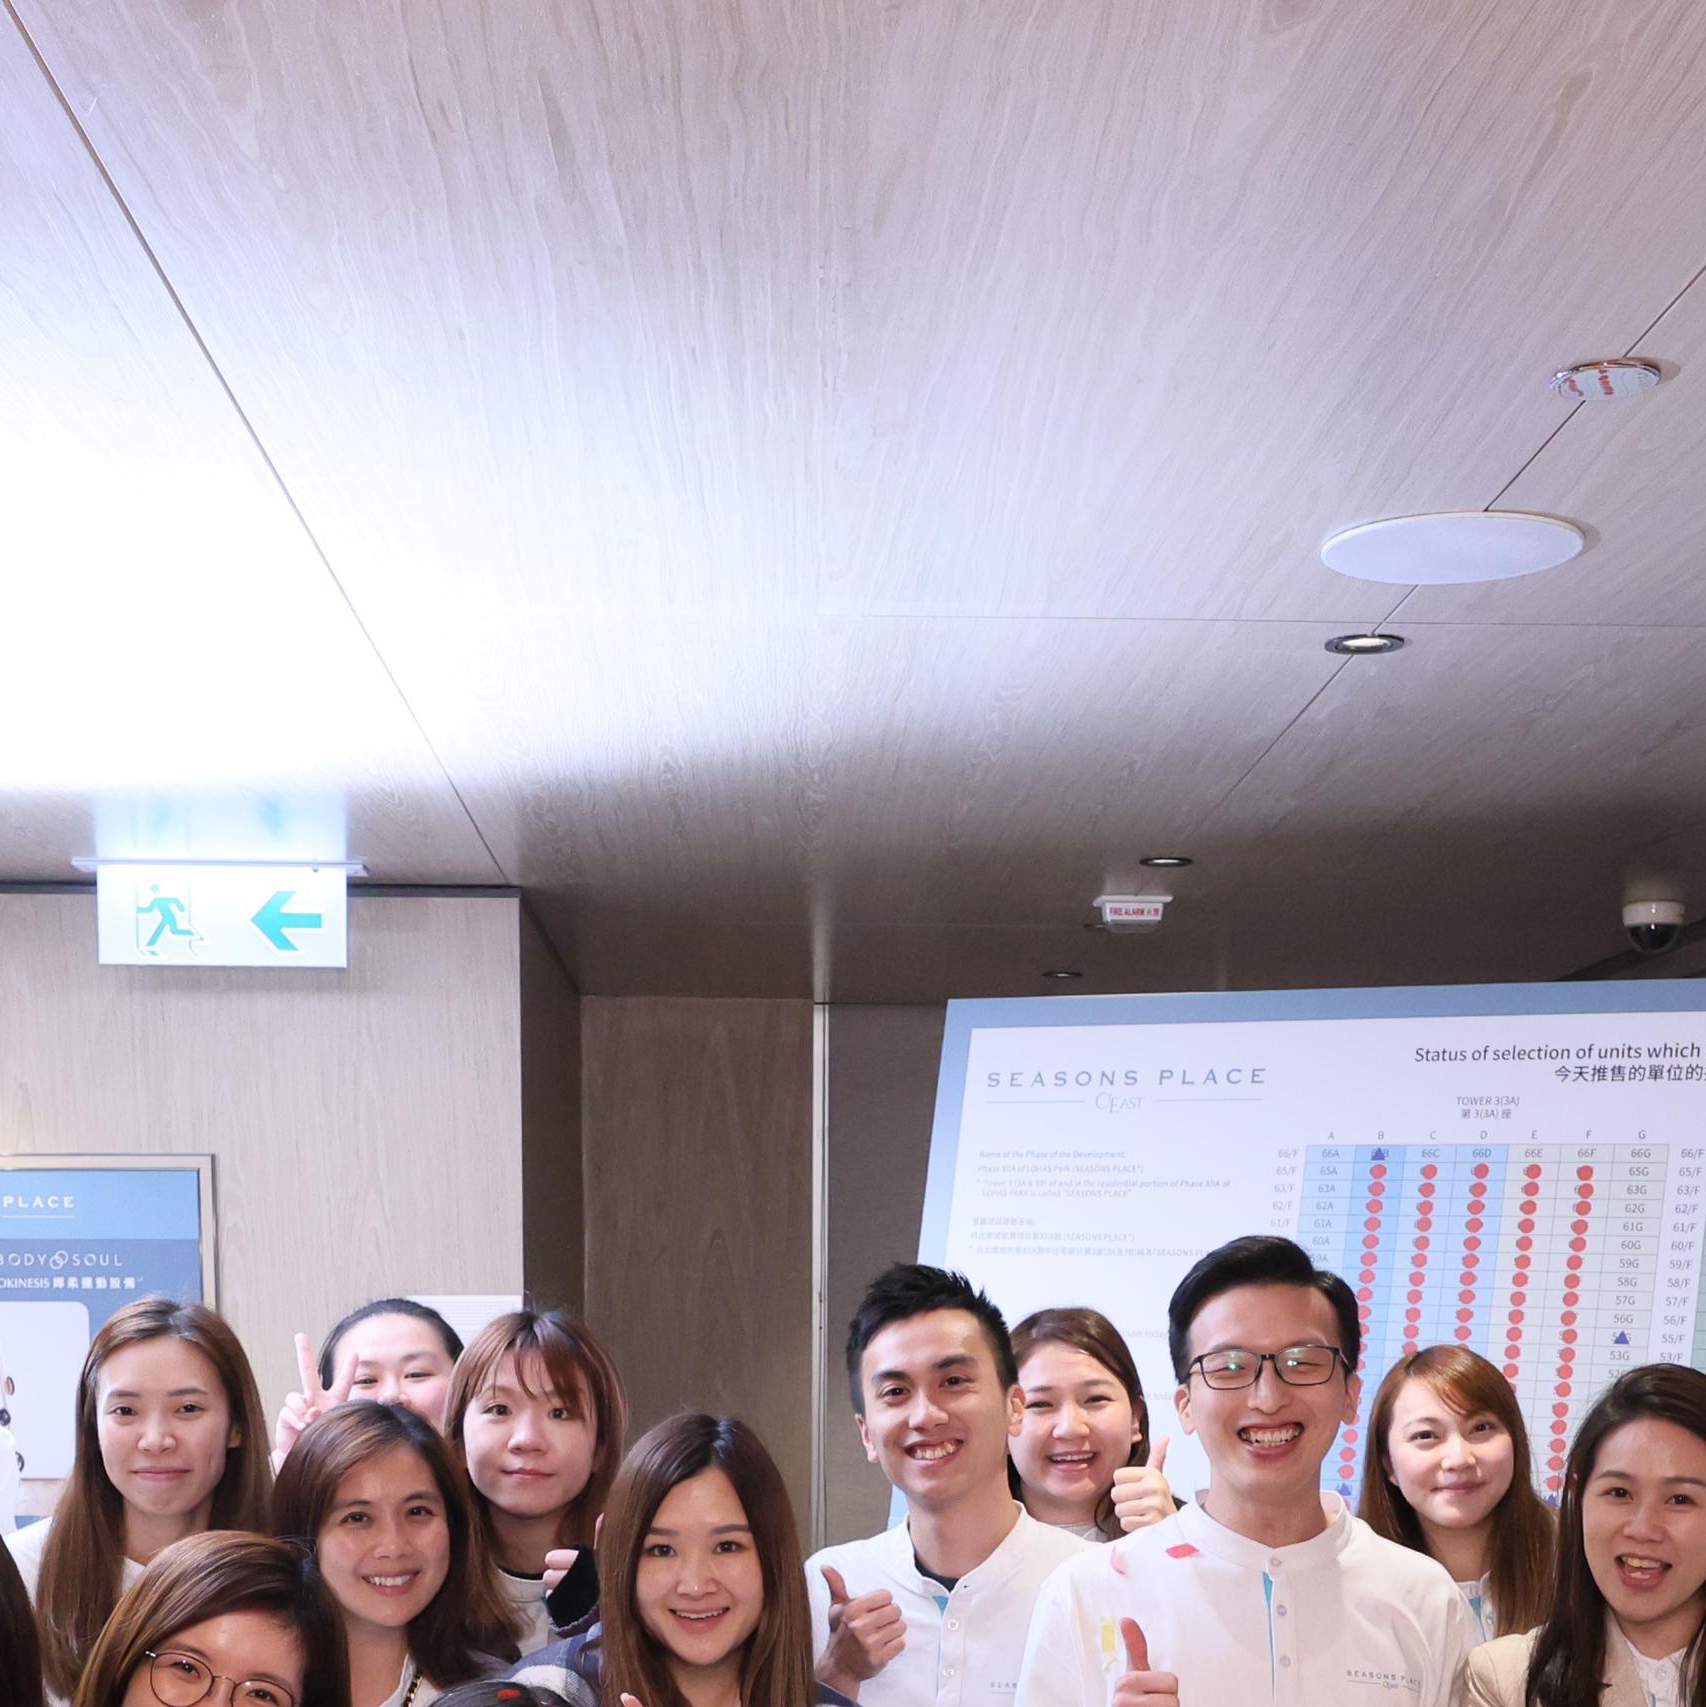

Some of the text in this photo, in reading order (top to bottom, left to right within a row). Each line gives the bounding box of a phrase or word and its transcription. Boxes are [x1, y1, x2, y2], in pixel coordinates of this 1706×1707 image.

[1415, 1047, 1467, 1062] Status
[1472, 1045, 1490, 1060] of
[1493, 1045, 1570, 1061] selection
[1576, 1044, 1594, 1059] of
[1598, 1043, 1642, 1059] units
[1647, 1042, 1701, 1058] which
[987, 1067, 1267, 1089] SEASONS PLACE
[1456, 1096, 1492, 1106] TOWER
[1327, 1130, 1646, 1140] A B C D E F G
[1321, 1150, 1339, 1158] 66A
[1421, 1149, 1440, 1158] 66C
[1472, 1149, 1492, 1158] 66D
[1524, 1149, 1543, 1158] 66E
[1577, 1149, 1596, 1158] 66F
[1631, 1149, 1651, 1158] 66G
[1681, 1149, 1705, 1160] 66/F
[1320, 1167, 1337, 1176] 65A
[1629, 1167, 1649, 1177] 65G
[1679, 1167, 1703, 1178] 65/F
[1318, 1184, 1336, 1193] 63A
[1627, 1186, 1647, 1195] 63G
[1677, 1186, 1701, 1196] 63/F
[3, 1196, 74, 1208] PLACE
[1316, 1202, 1334, 1210] 62A
[1625, 1204, 1645, 1213] 62G
[1675, 1204, 1699, 1214] 62/F
[1314, 1219, 1331, 1228] 61A
[1623, 1222, 1643, 1232] 61G
[1673, 1222, 1697, 1233] 61/F
[1621, 1241, 1641, 1250] 60G
[1671, 1241, 1695, 1251] 60/F
[73, 1254, 123, 1266] SOUL
[1619, 1259, 1639, 1269] 59G
[1669, 1259, 1693, 1270] 59/F
[1617, 1277, 1637, 1287] 58G
[1667, 1278, 1691, 1289] 58/F
[1615, 1296, 1689, 1307] 57G 57/F
[1613, 1314, 1634, 1324] 56G
[1663, 1315, 1688, 1326] 56/F
[1661, 1333, 1685, 1345] 55/F
[1609, 1351, 1630, 1360] 53G
[1660, 1352, 1684, 1363] 53/F
